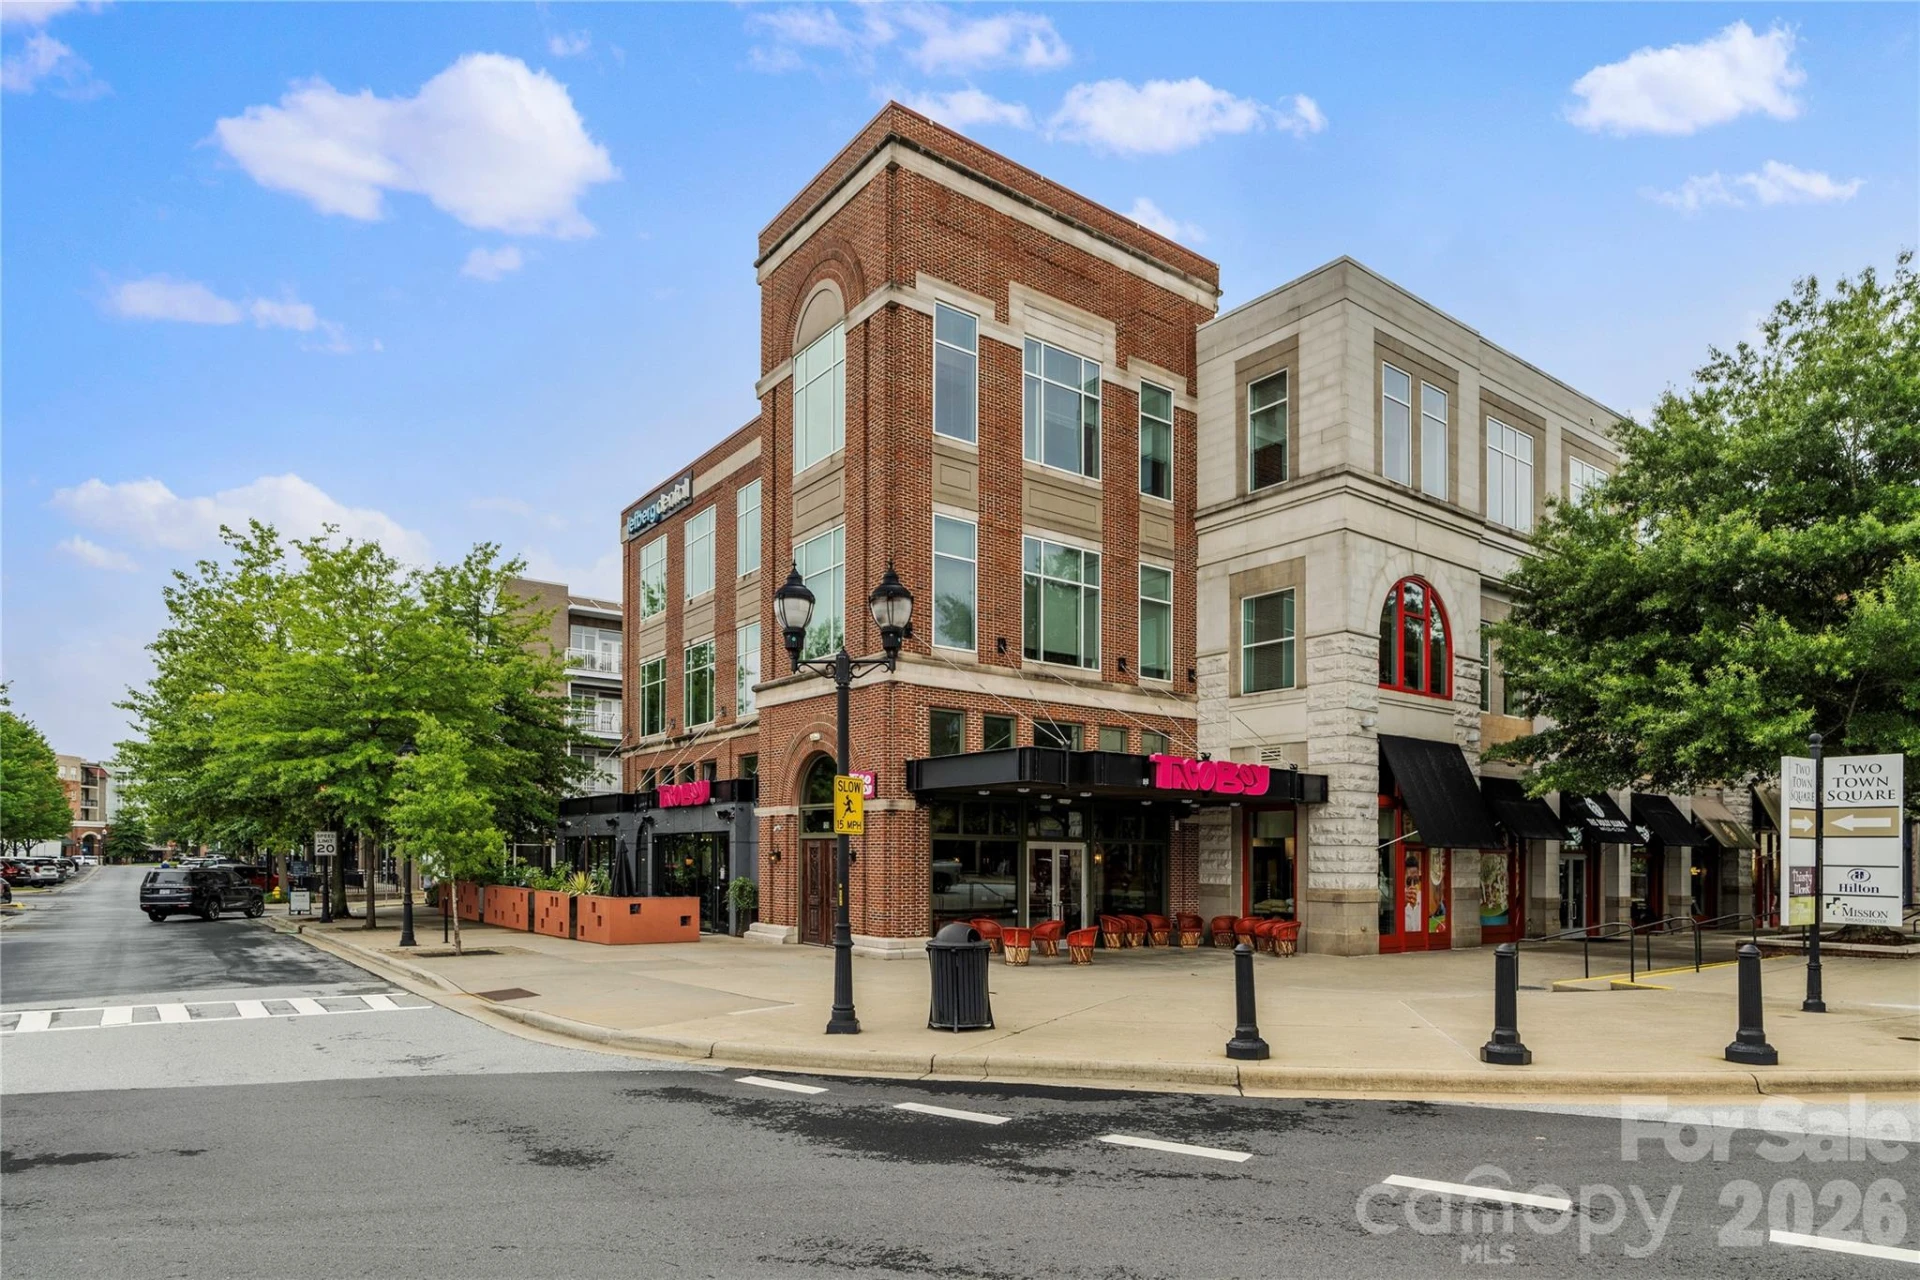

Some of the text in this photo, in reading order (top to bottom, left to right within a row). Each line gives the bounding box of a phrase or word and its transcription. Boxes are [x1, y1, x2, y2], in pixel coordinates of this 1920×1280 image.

[656, 478, 690, 515] dental
[1795, 763, 1811, 776] TWO
[1839, 763, 1882, 775] TWO
[837, 780, 861, 793] SLOW
[1792, 777, 1813, 788] TOWN
[1832, 776, 1889, 788] TOWN
[1827, 789, 1896, 803] SQUARE
[837, 820, 862, 830] 15 MPH
[317, 844, 335, 853] 20
[1839, 883, 1880, 894] Hilton
[1842, 907, 1888, 918] MISSION
